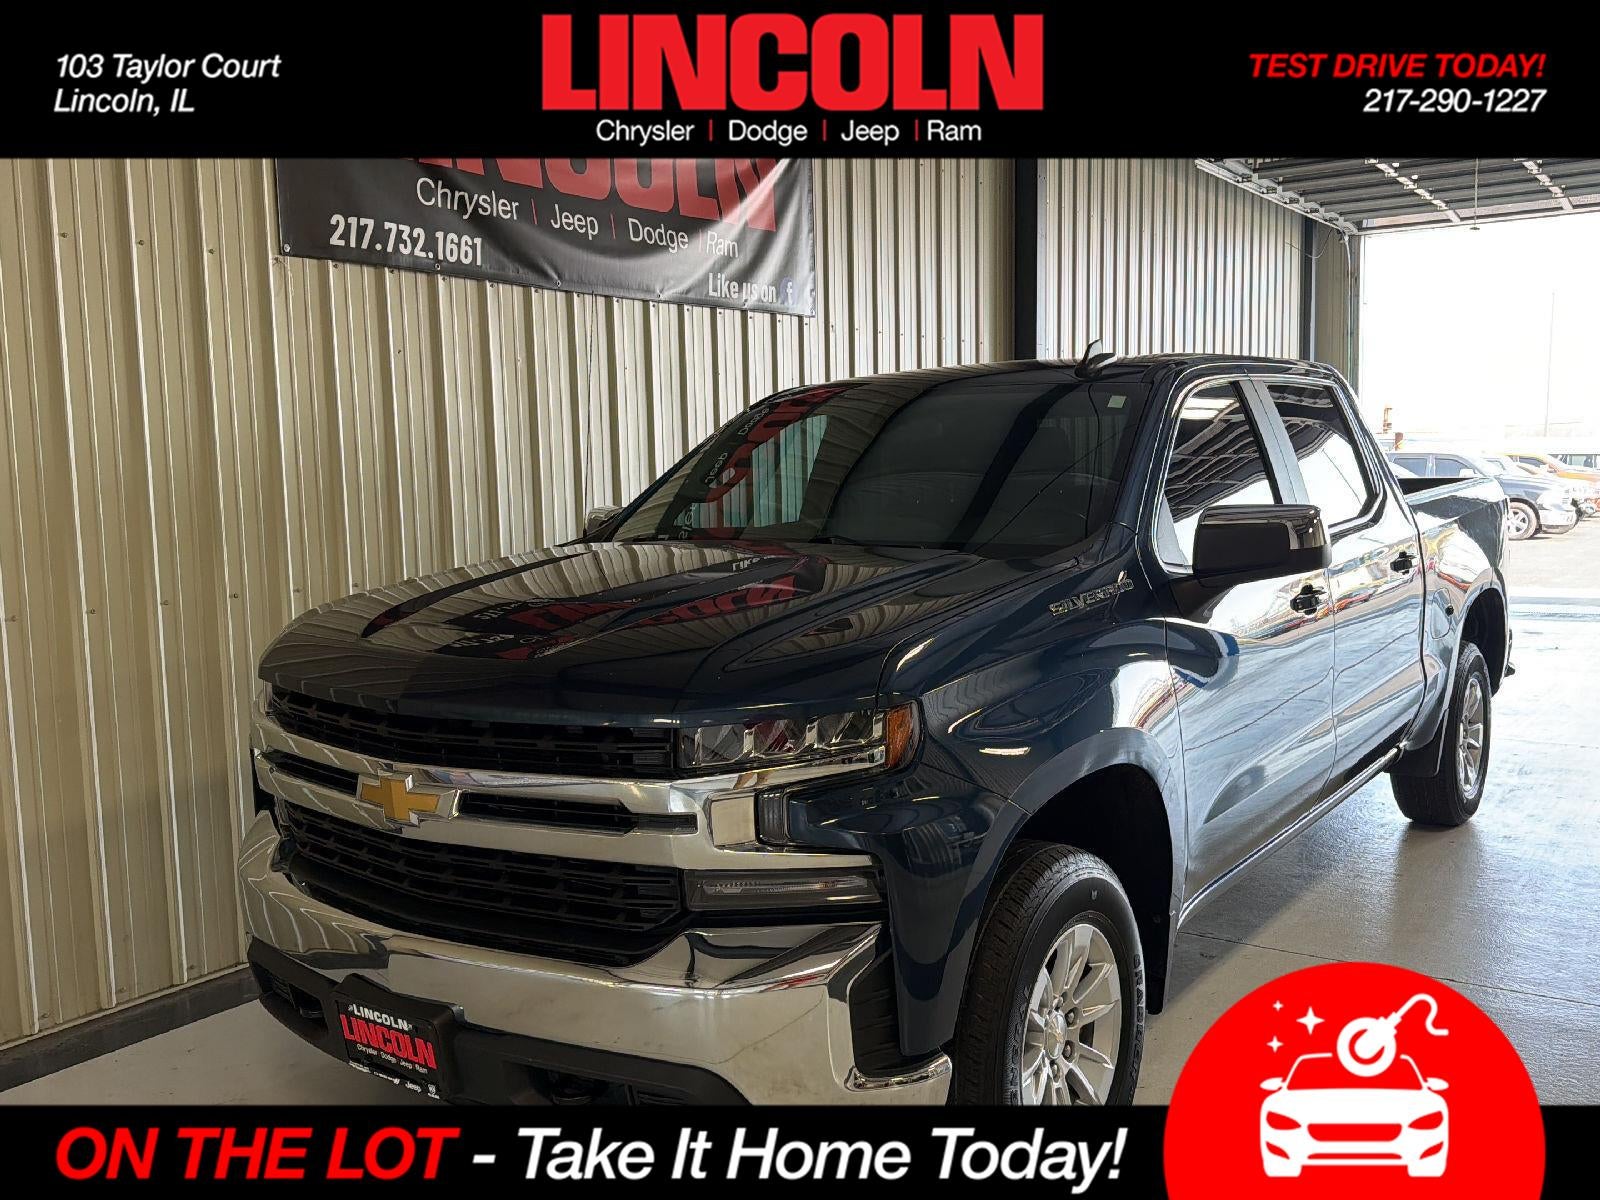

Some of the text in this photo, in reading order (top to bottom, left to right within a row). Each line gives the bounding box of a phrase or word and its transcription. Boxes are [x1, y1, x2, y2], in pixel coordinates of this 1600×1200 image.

[329, 213, 483, 267] 217.732.1661
[415, 176, 520, 221] Chrysler
[550, 203, 599, 237] Jeep
[627, 217, 690, 251] Dodge
[706, 230, 739, 259] Ram
[708, 272, 739, 299] Like
[760, 284, 776, 304] on
[340, 1014, 437, 1069] LINCOLN
